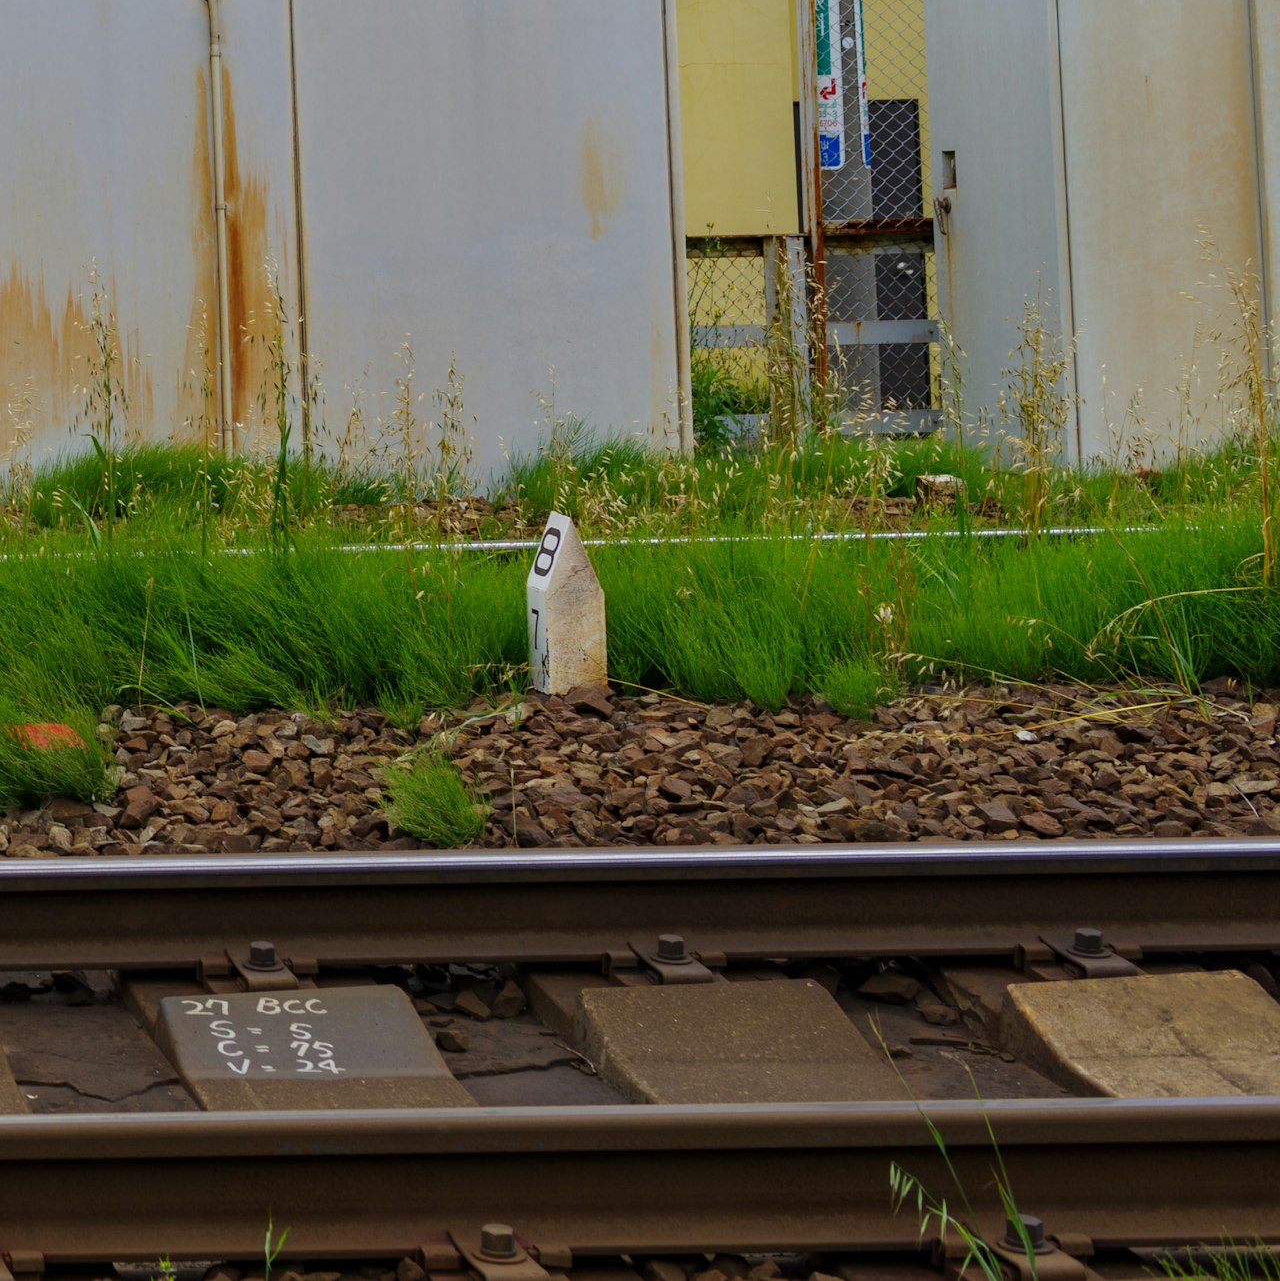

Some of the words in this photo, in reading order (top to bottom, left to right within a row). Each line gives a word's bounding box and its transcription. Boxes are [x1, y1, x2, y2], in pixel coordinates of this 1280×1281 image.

[534, 527, 561, 577] 8
[181, 999, 229, 1016] 27
[256, 997, 328, 1015] BCC
[209, 1020, 237, 1039] S
[289, 1022, 313, 1040] 5
[217, 1040, 244, 1057] C
[290, 1041, 334, 1058] 75
[226, 1058, 251, 1075] V
[296, 1058, 346, 1075] 24
